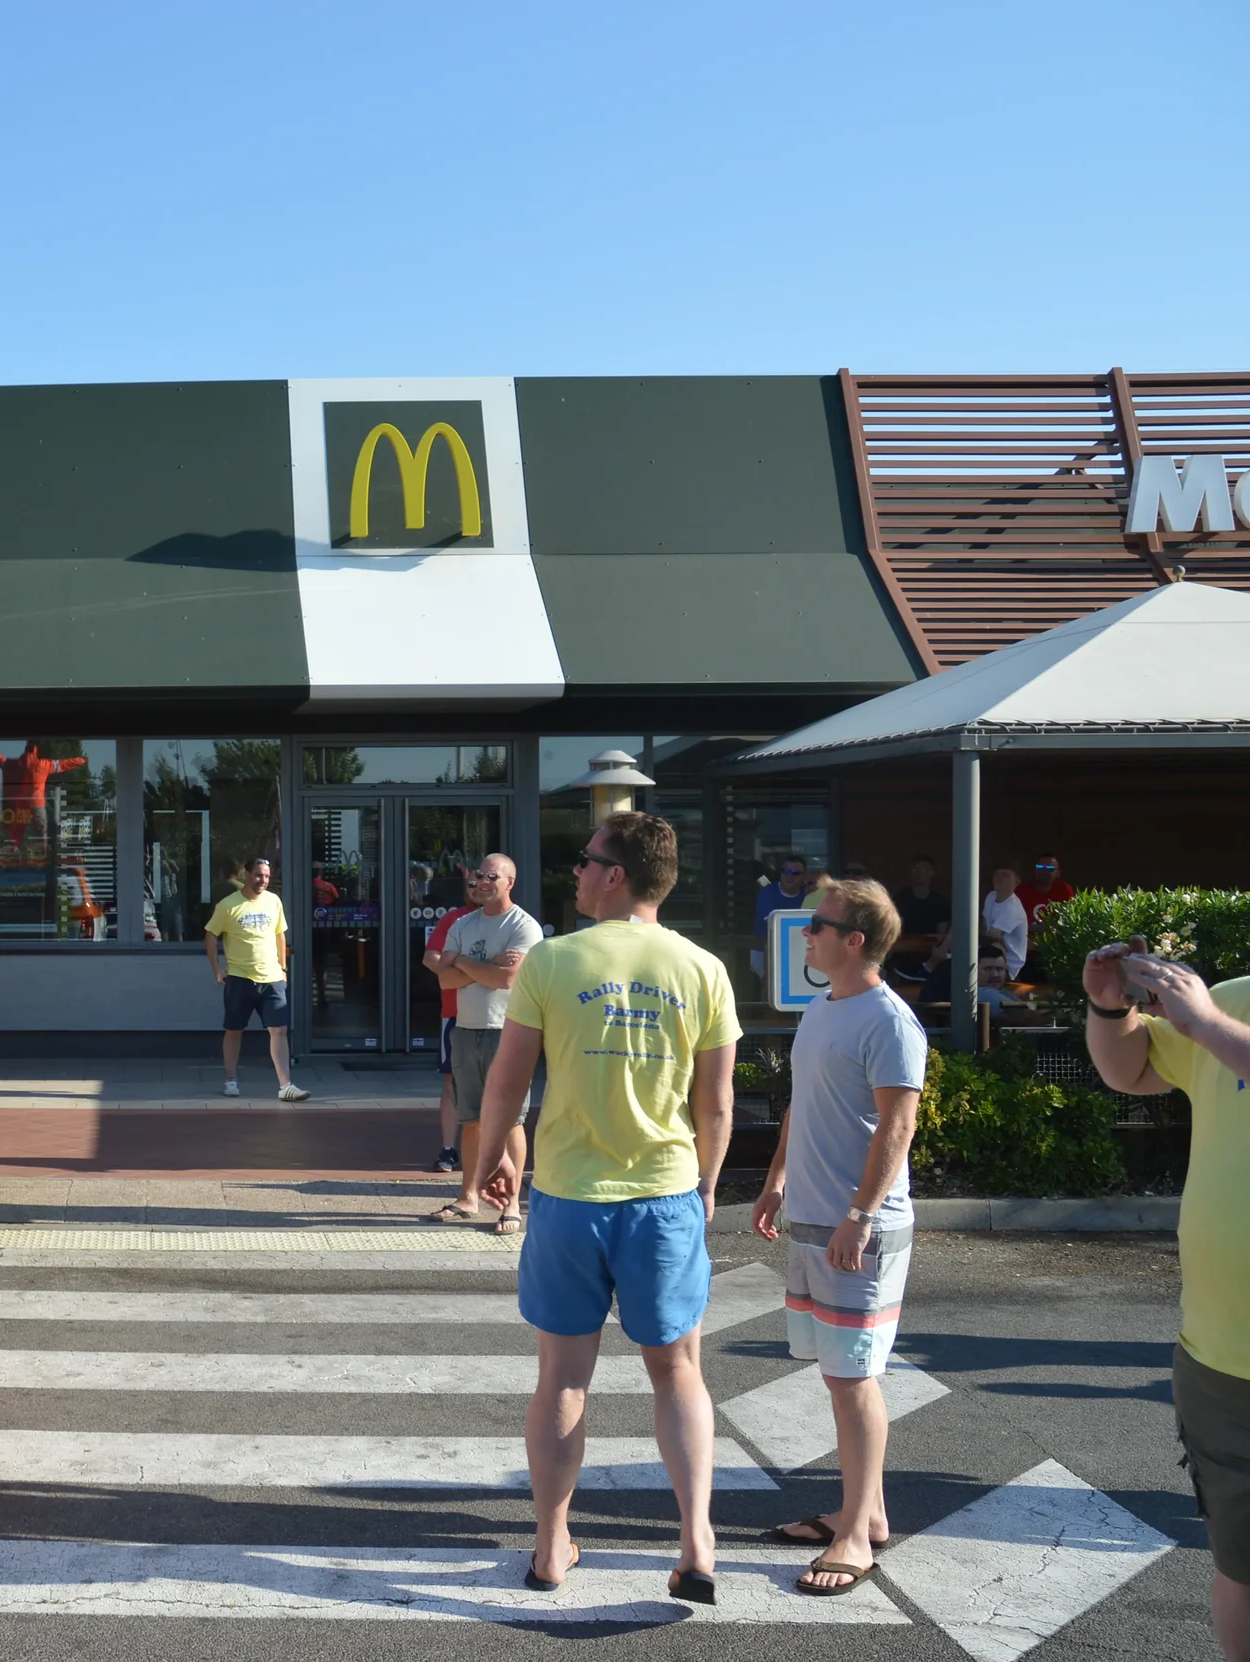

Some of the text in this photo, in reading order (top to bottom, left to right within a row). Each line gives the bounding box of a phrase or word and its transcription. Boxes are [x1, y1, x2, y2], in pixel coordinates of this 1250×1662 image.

[577, 981, 686, 1010] Rally Driver
[604, 1004, 661, 1021] Barmy
[615, 1019, 660, 1030] Barcelona
[583, 1049, 675, 1061] www.wackyrally.co.uk
